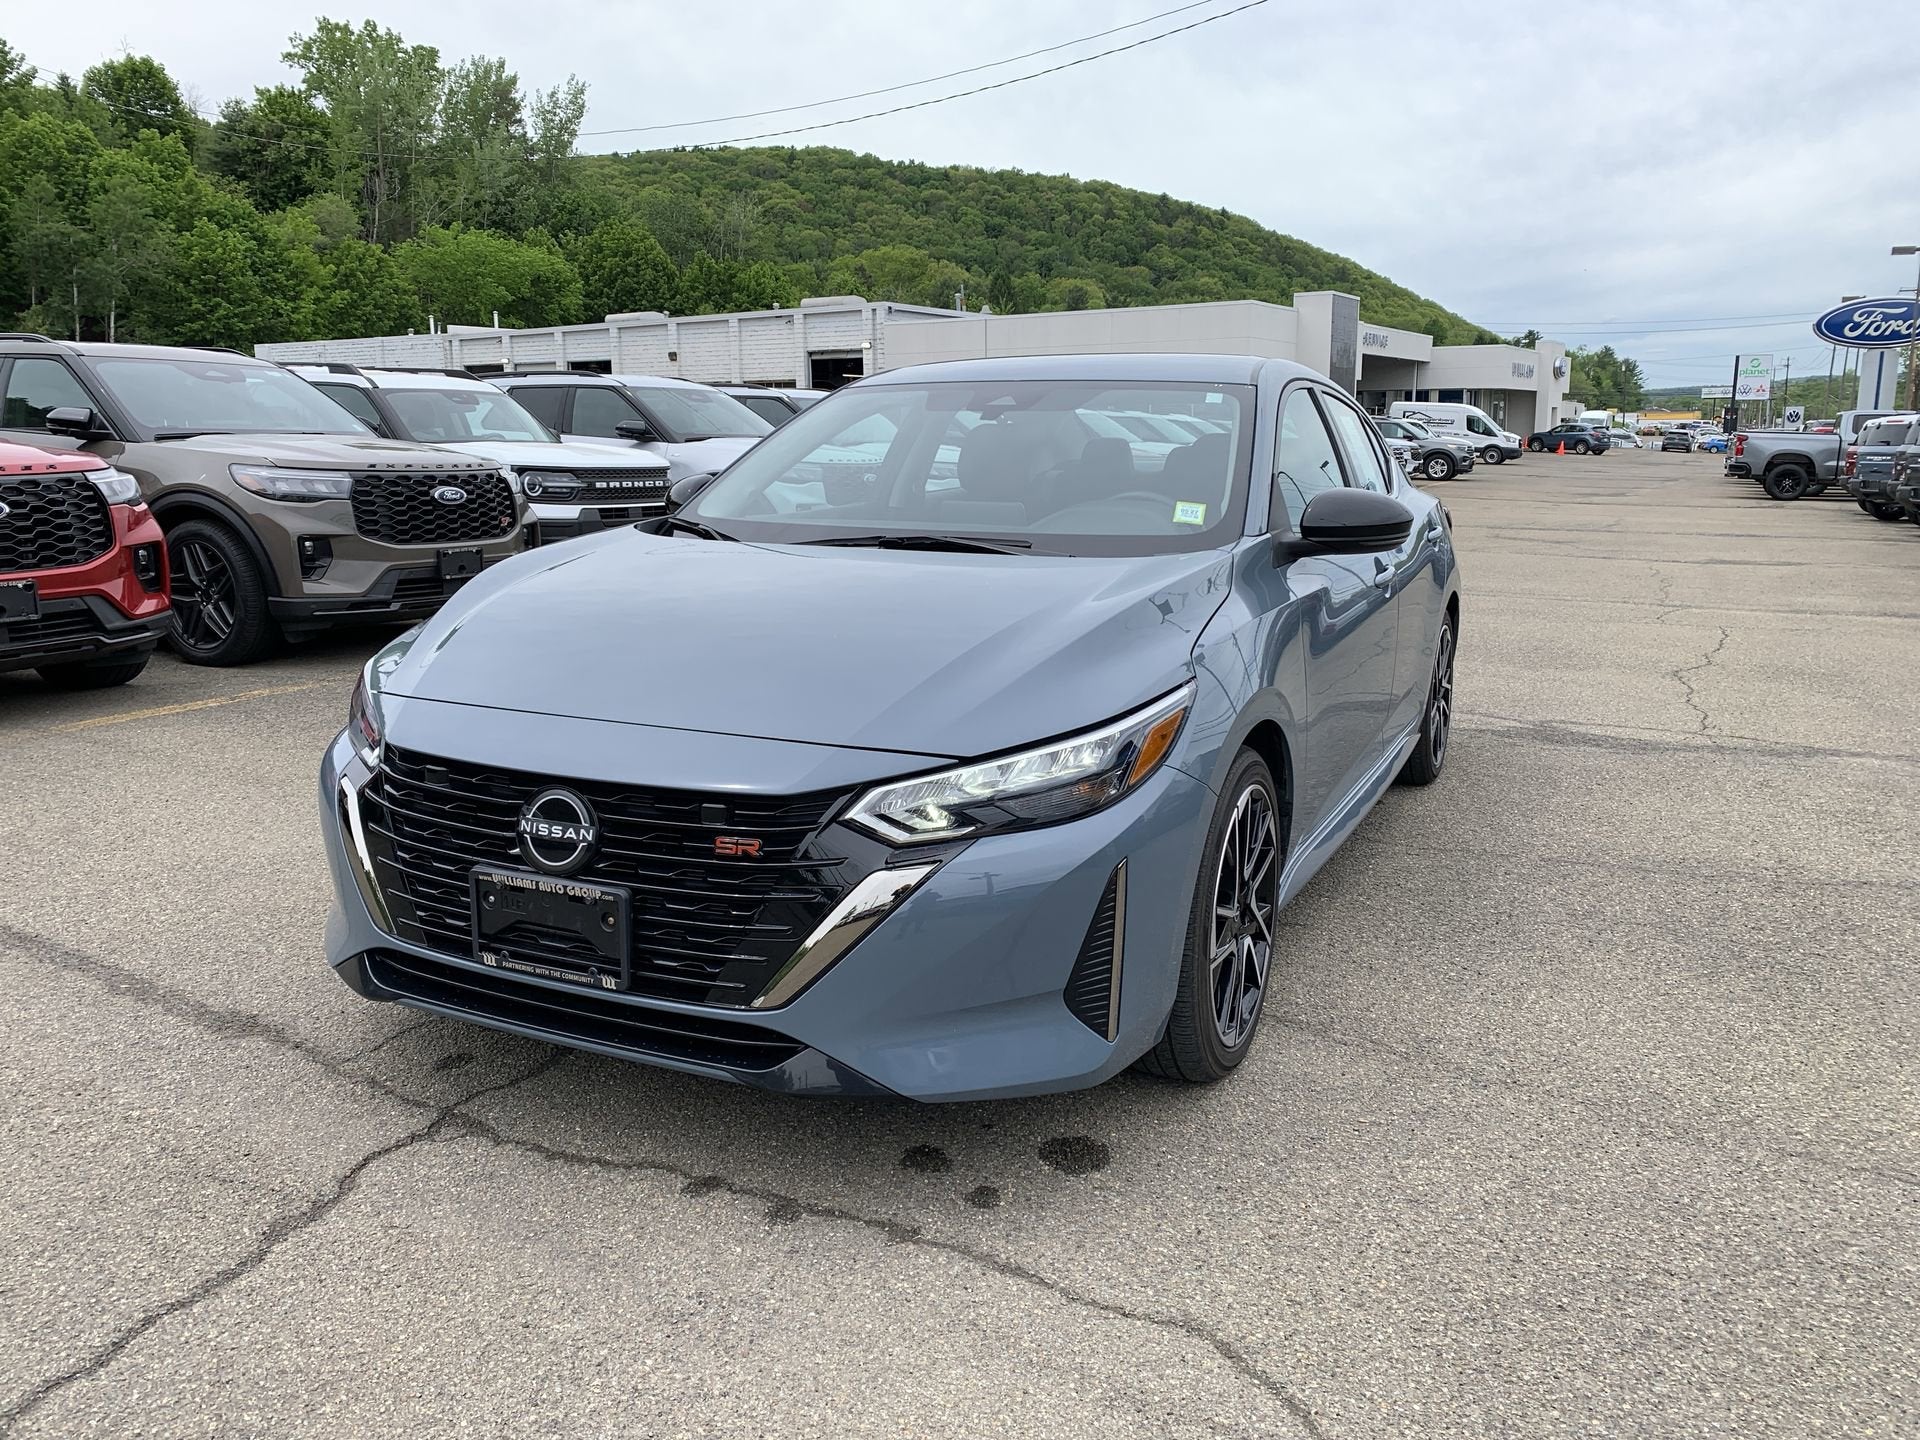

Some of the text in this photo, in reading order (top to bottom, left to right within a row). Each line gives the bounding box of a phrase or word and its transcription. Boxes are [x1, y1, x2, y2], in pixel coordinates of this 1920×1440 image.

[1739, 367, 1771, 377] planet
[520, 819, 593, 841] NISSAN
[715, 837, 763, 856] SR
[539, 880, 565, 894] AUTO
[502, 961, 595, 984] PARTNERING WITH THE COMMUNITY
